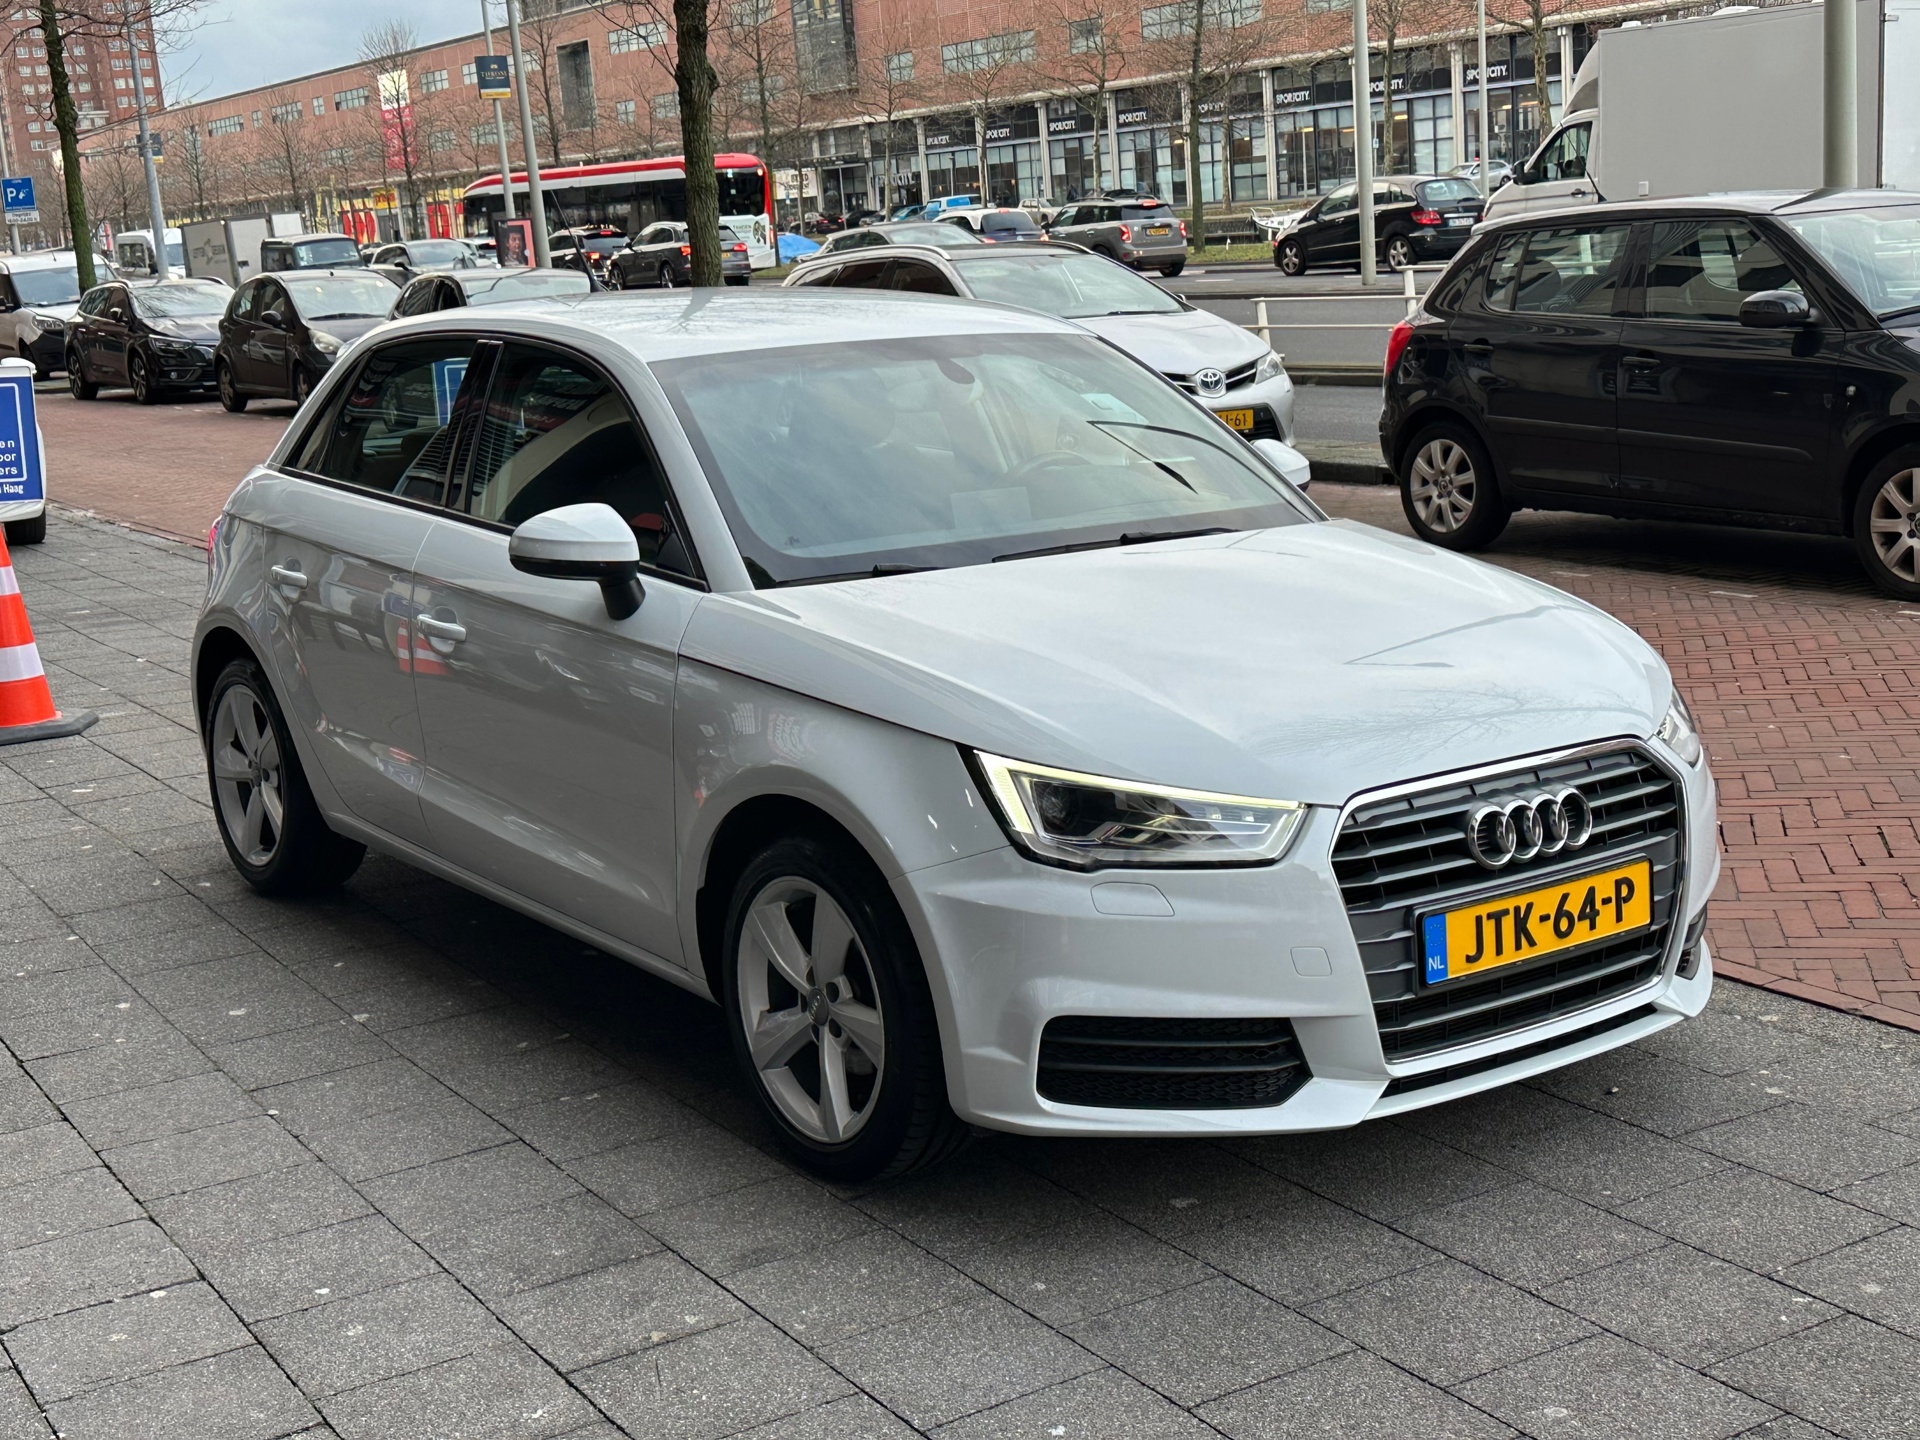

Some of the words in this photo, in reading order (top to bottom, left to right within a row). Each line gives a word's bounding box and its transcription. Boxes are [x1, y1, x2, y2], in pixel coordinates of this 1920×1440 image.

[6, 187, 17, 203] P
[3, 484, 24, 494] Haag
[1465, 876, 1635, 964] JTK-64-P
[1428, 957, 1445, 971] NL
